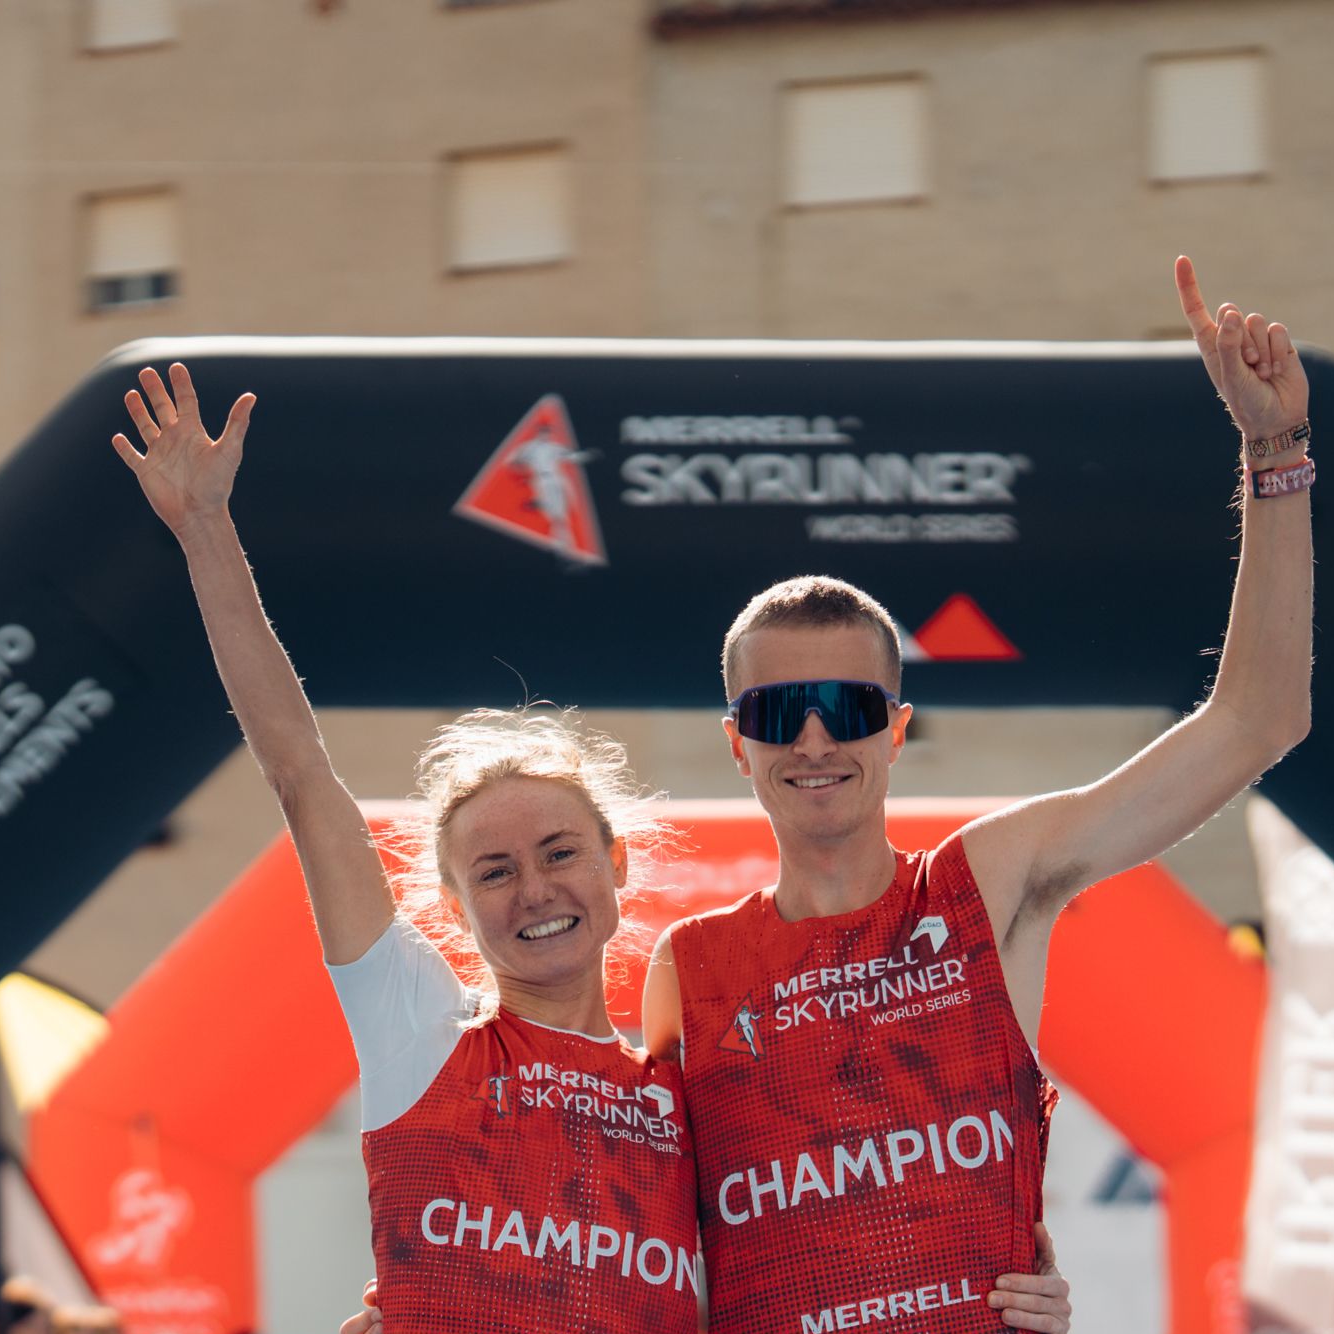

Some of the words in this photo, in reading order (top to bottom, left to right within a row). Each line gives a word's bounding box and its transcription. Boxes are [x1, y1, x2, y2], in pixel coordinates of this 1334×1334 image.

[620, 416, 855, 444] MERRELL
[620, 453, 1021, 505] SKYRUNNER
[806, 514, 913, 542] WORLD
[919, 514, 1020, 542] SERIES
[774, 945, 919, 1000] MERRELL
[774, 959, 966, 1032] SKYRUNNER
[870, 1004, 922, 1027] WORLD
[925, 989, 972, 1013] SERIES
[518, 1062, 644, 1104] MERRELL
[521, 1086, 681, 1143] SKYRUNNER
[602, 1126, 644, 1144] WORLD
[649, 1136, 681, 1155] SERIES
[421, 1199, 698, 1296] CHAMPION
